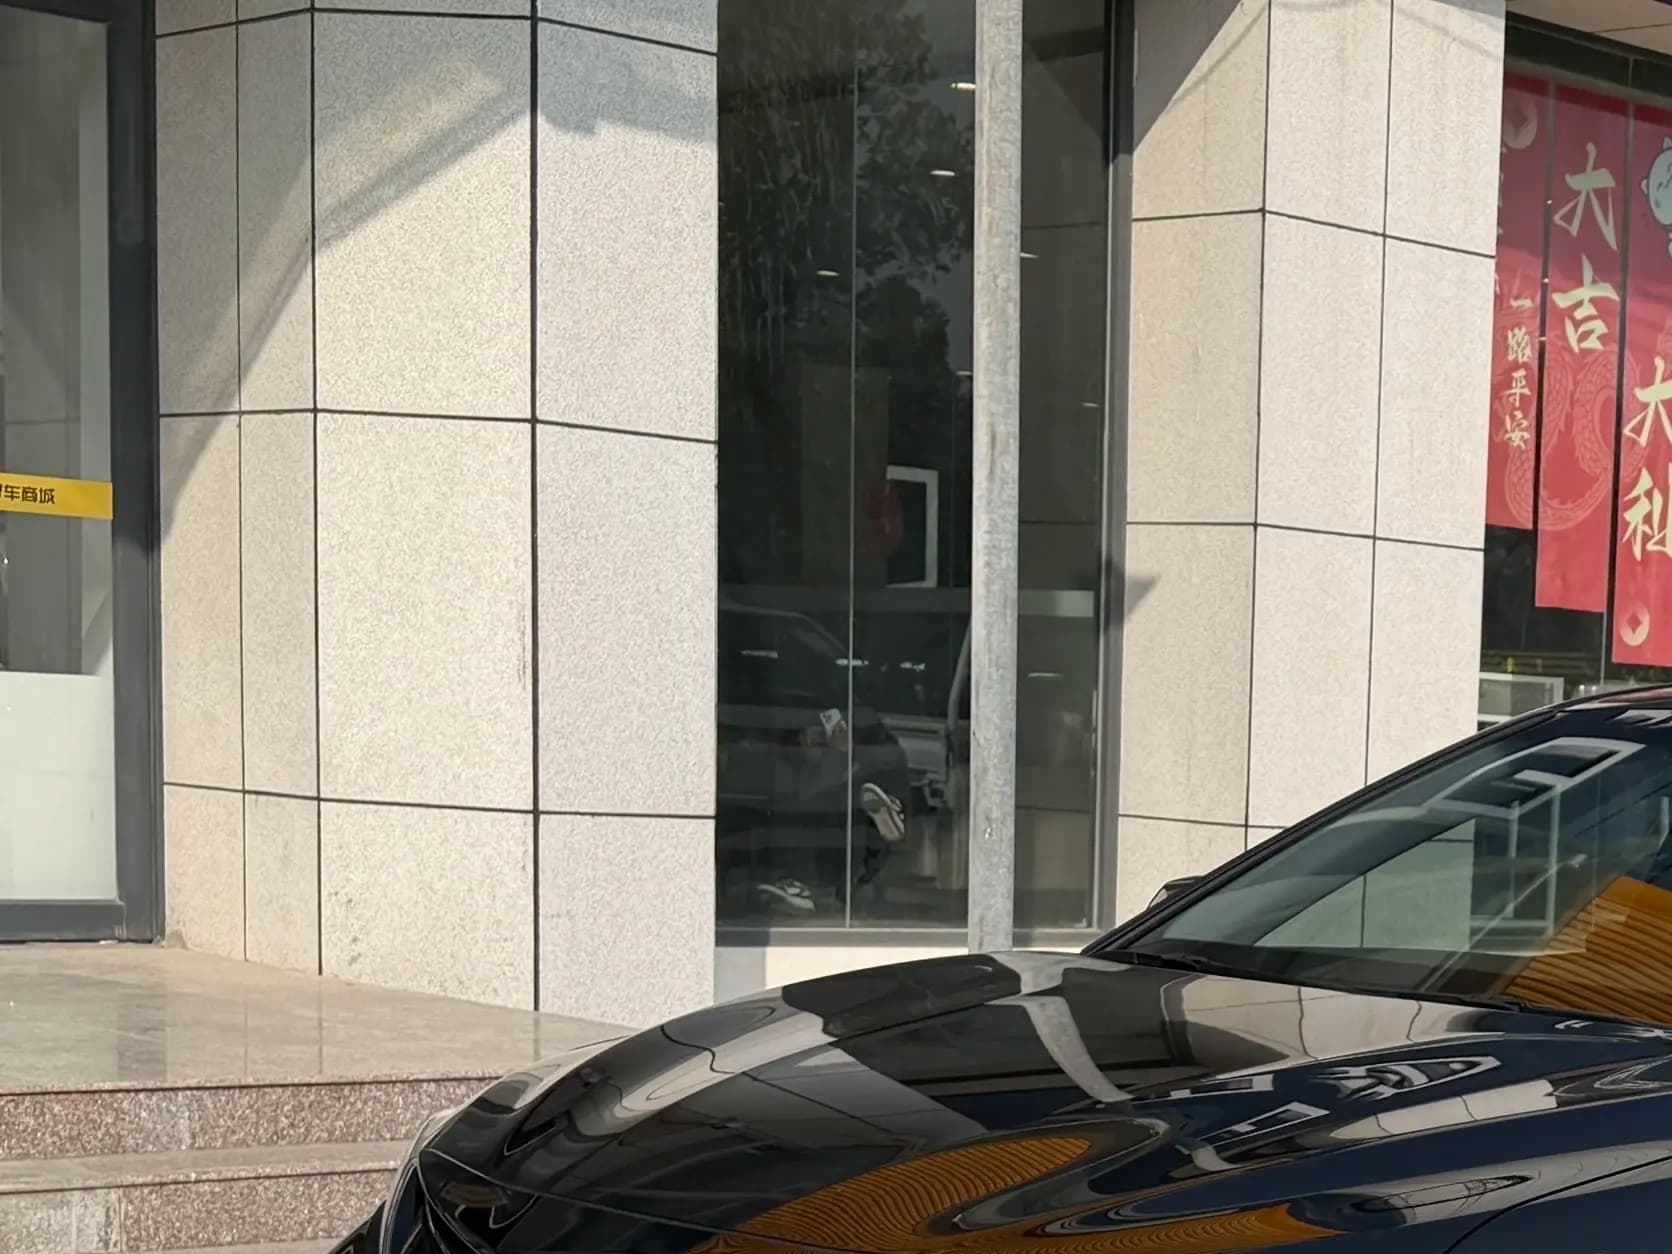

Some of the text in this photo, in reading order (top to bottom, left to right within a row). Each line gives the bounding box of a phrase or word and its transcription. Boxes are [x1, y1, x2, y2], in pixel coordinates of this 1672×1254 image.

[1552, 142, 1619, 354] 大吉
[1504, 298, 1534, 448] 一路平安
[0, 483, 55, 505] 车商城
